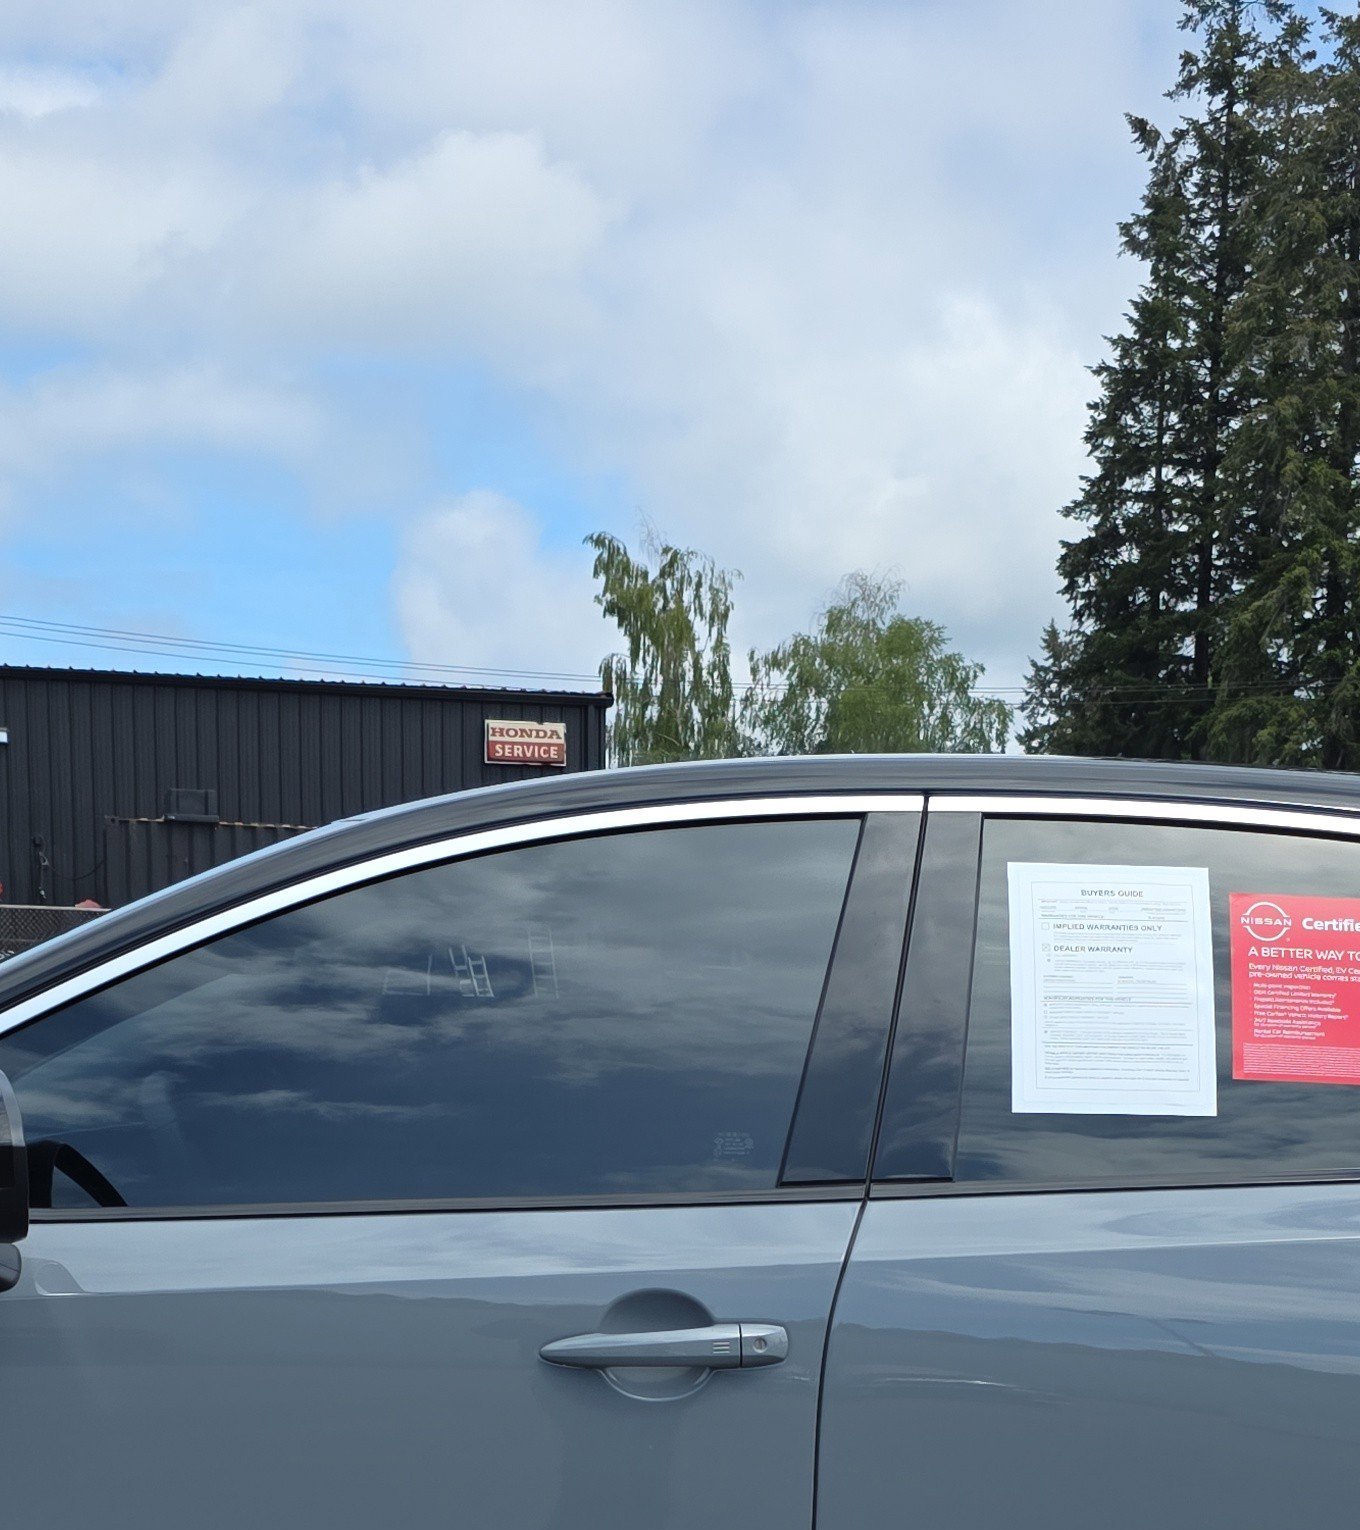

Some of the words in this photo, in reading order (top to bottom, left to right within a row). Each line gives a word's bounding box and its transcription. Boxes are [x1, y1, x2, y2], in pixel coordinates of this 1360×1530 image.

[490, 727, 562, 739] HONDA
[495, 745, 558, 758] SERVICE
[1081, 889, 1116, 897] BUYERS
[1053, 923, 1085, 931] IMPLIED
[1240, 916, 1292, 927] NISSAN
[1248, 946, 1258, 957] A
[1262, 947, 1313, 959] BETTER
[1316, 950, 1345, 960] WAY
